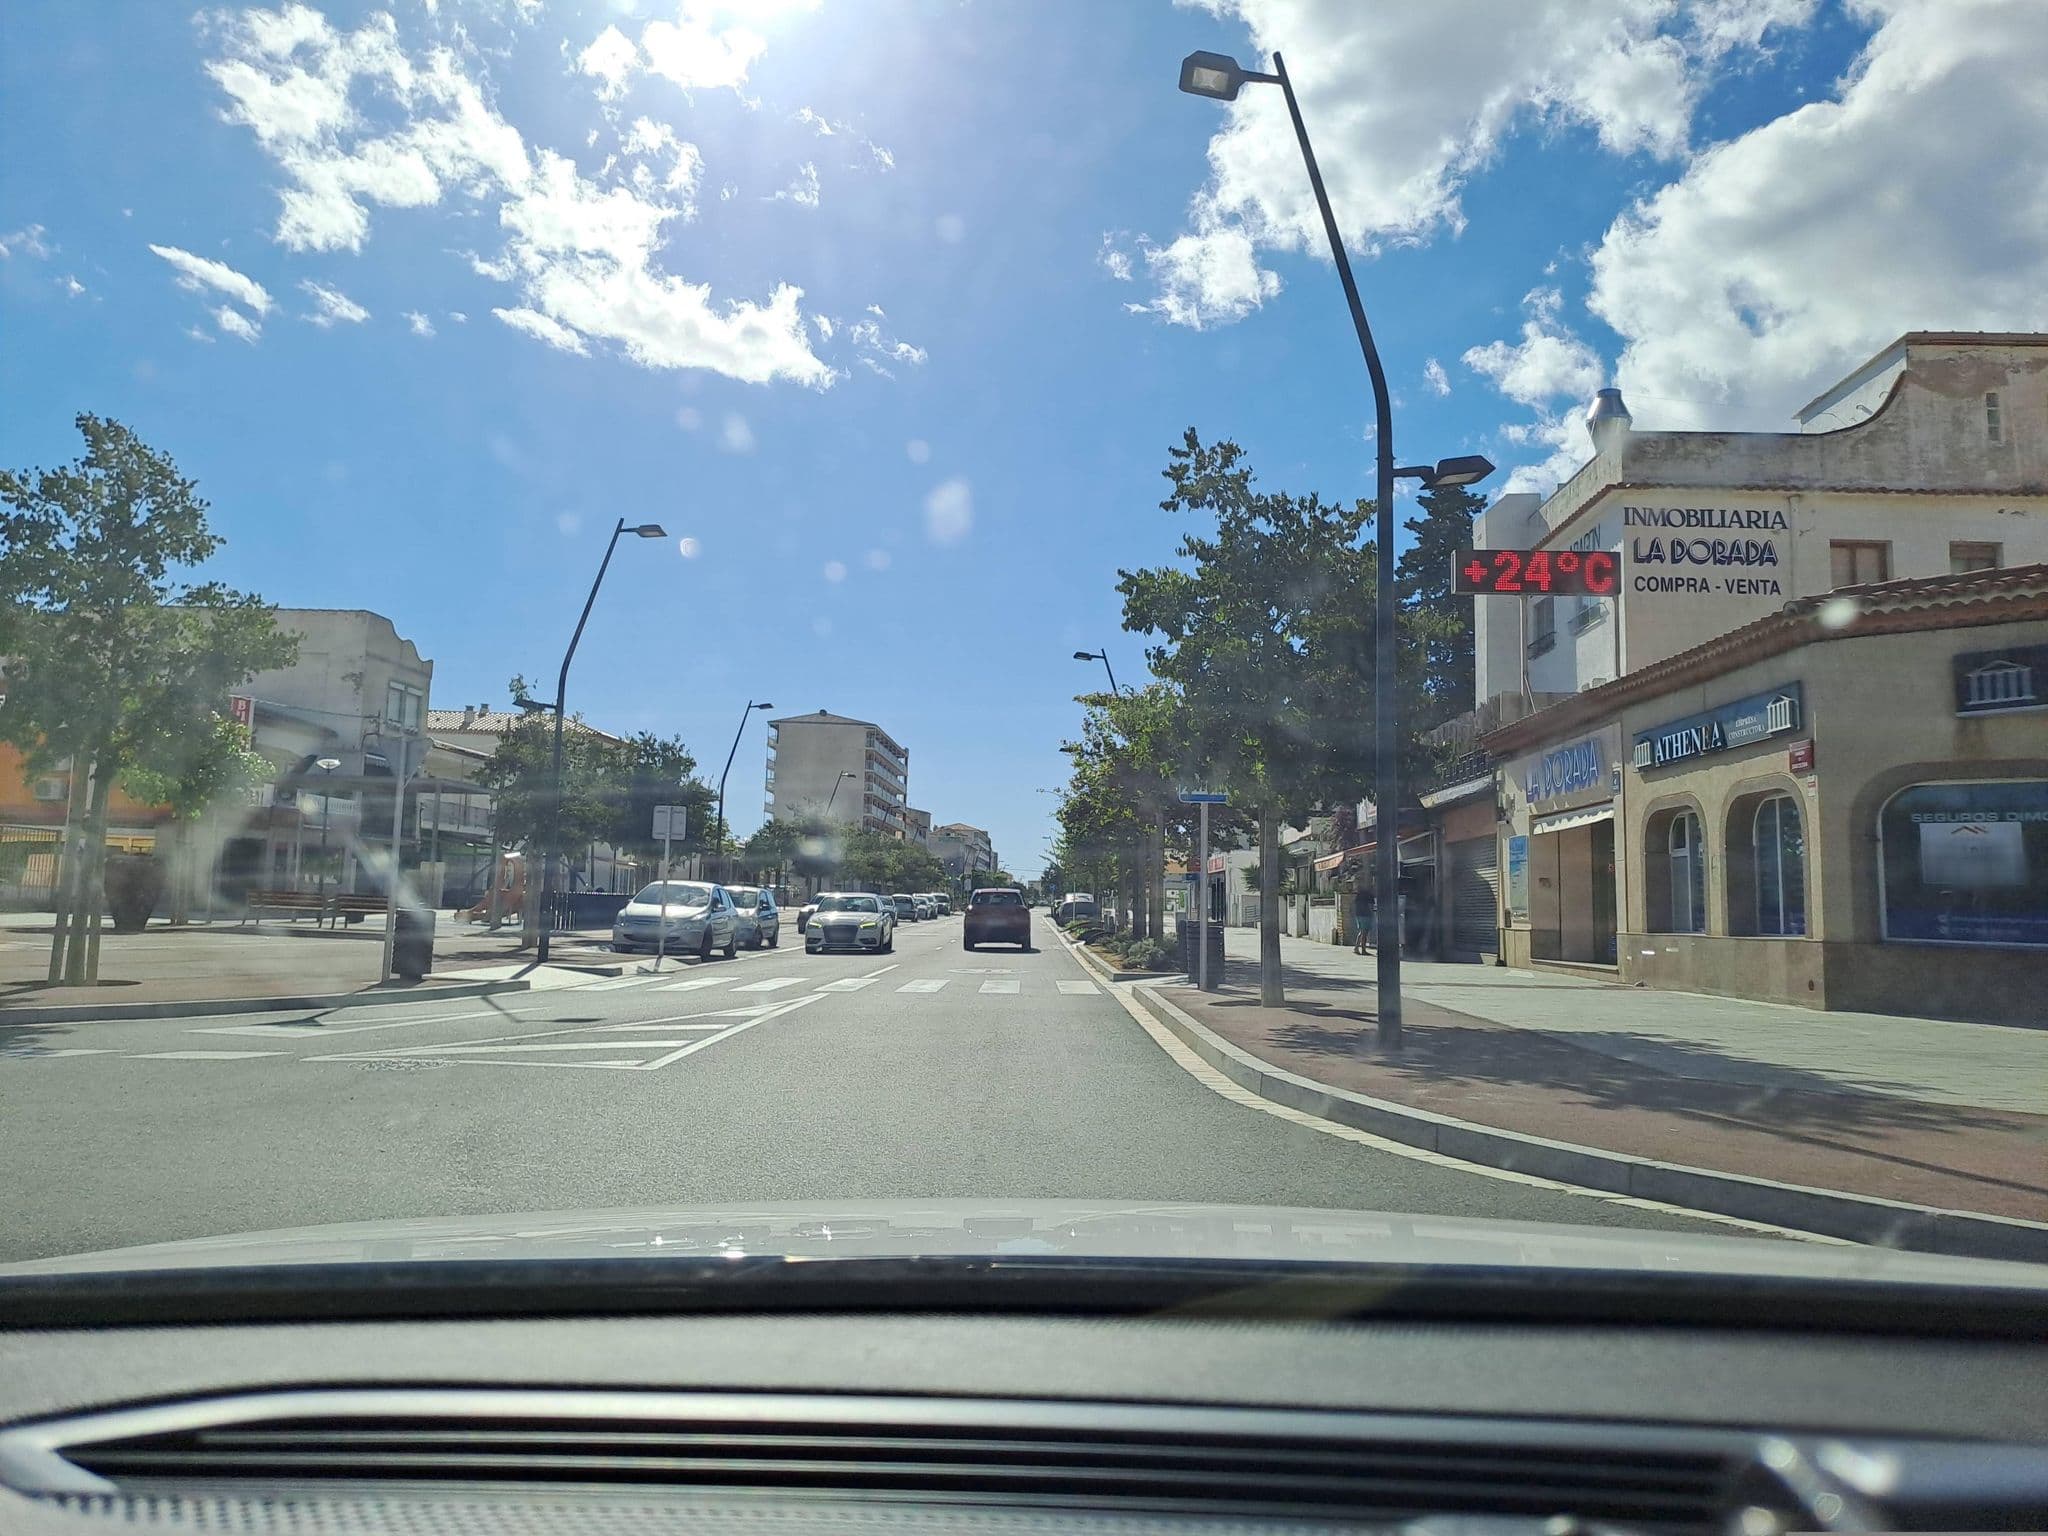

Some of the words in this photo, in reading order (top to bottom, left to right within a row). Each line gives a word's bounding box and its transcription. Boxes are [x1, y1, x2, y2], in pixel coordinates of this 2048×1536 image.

[1624, 506, 1789, 530] INMOBILIARIA
[1633, 537, 1666, 564] LA
[1670, 537, 1779, 567] DORADA
[1634, 576, 1711, 594] COMPRA
[1725, 578, 1782, 596] VENTA
[1655, 721, 1723, 766] ATHENEA
[1526, 766, 1541, 804] LA
[1543, 740, 1600, 799] DORADA
[1911, 812, 1999, 823] SEGUROS
